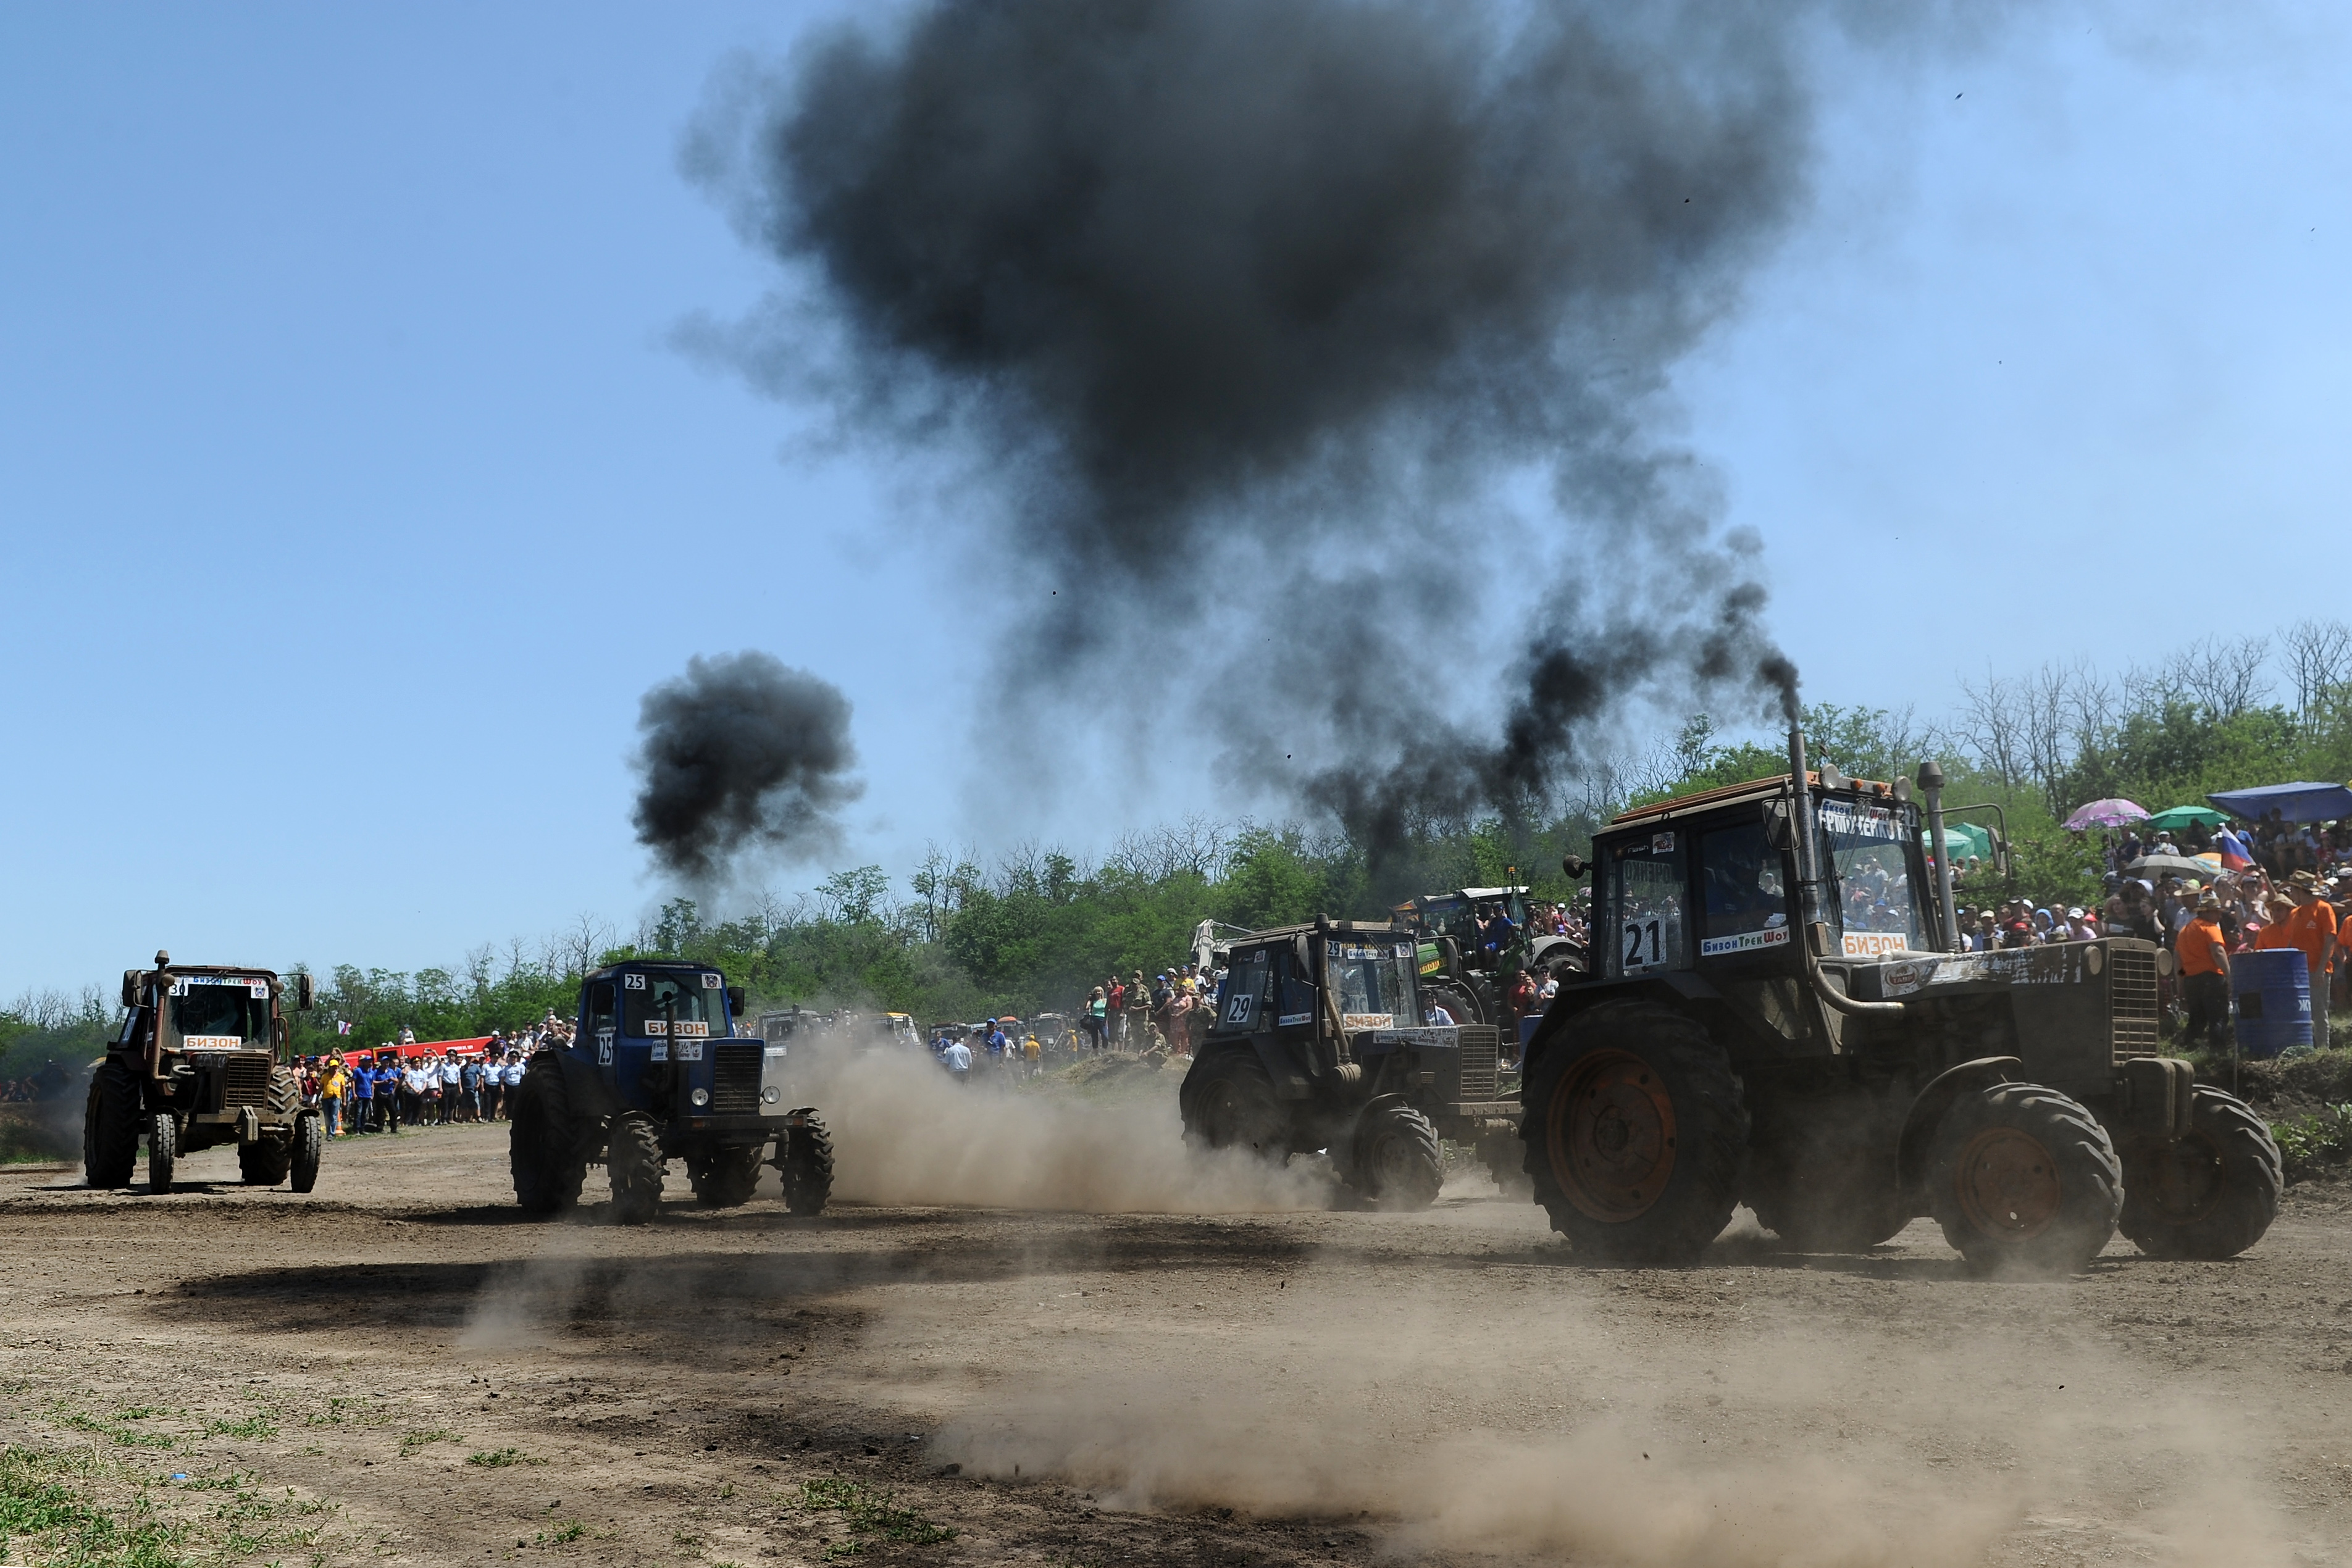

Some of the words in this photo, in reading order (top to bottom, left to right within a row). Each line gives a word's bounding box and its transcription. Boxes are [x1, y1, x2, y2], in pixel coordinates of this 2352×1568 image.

[1327, 941, 1340, 956] 29
[1625, 920, 1660, 966] 21
[1844, 935, 1905, 955] БИЗОН
[170, 984, 185, 995] 30
[627, 975, 643, 988] 25
[1229, 997, 1250, 1021] 29
[186, 1038, 238, 1048] БИЗОН
[600, 1036, 611, 1063] 25
